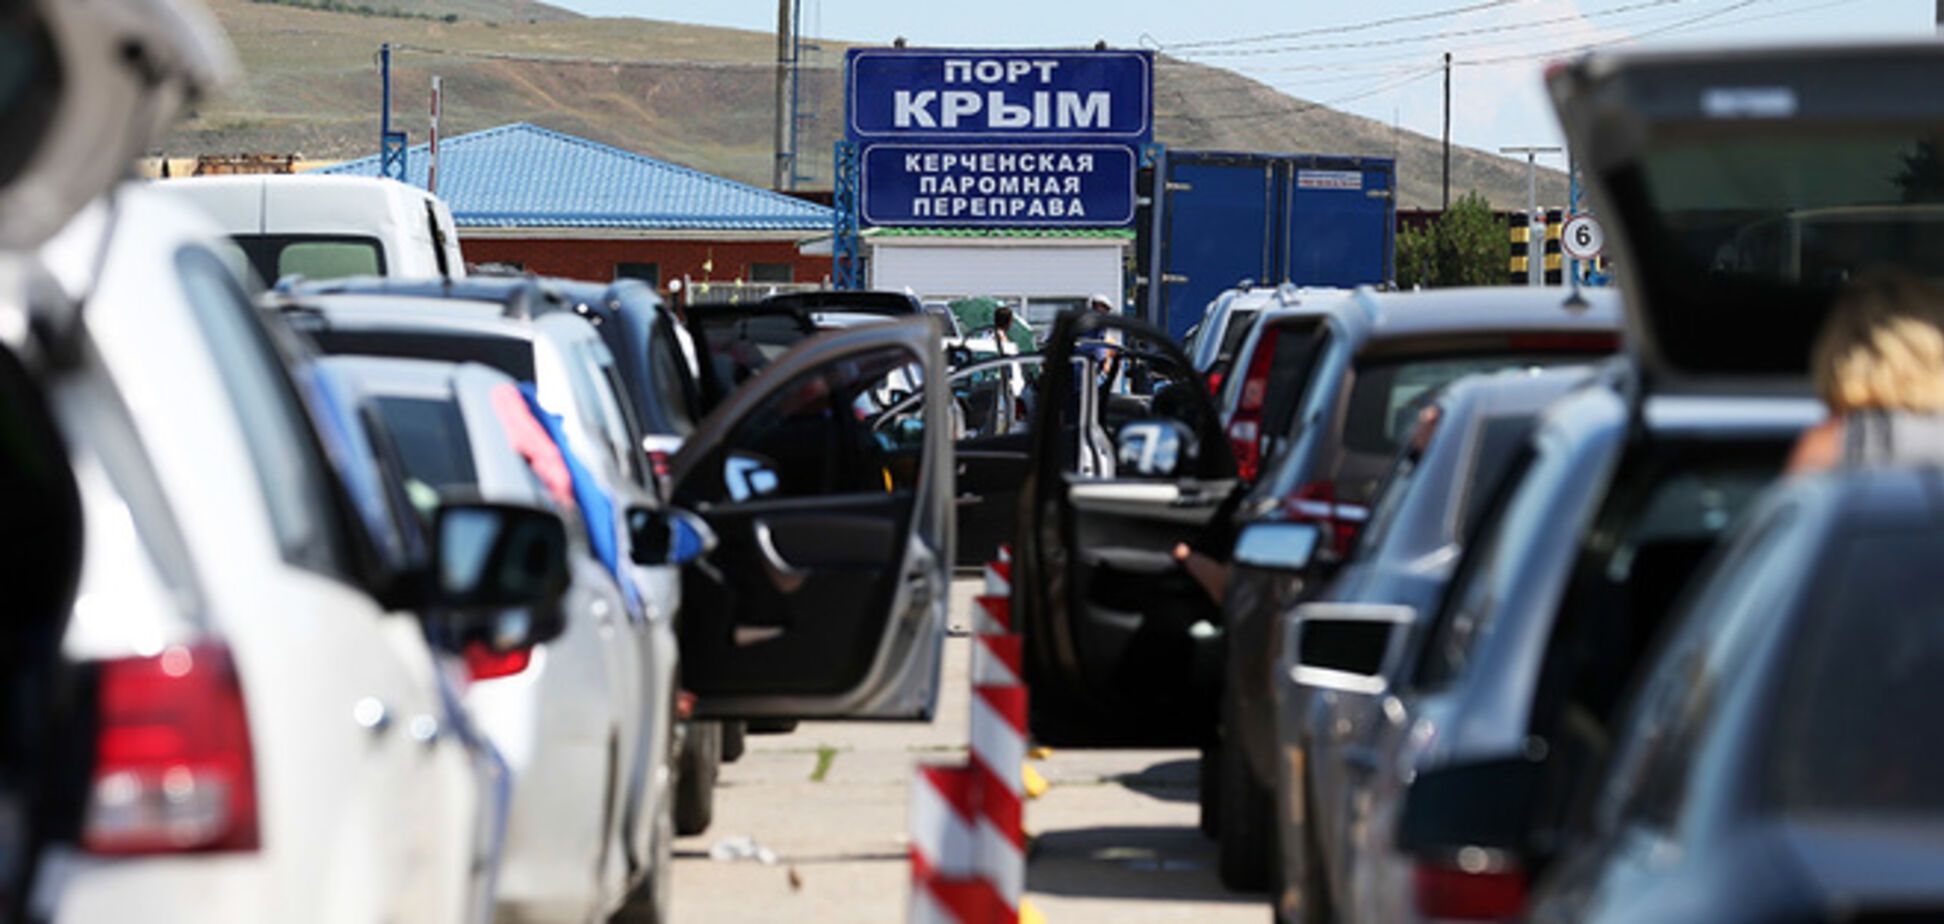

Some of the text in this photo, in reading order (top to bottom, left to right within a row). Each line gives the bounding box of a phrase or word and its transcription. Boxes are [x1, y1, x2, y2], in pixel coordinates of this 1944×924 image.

[944, 60, 1058, 83] ПОРТ
[894, 90, 1111, 128] КРЫМ
[905, 153, 1094, 172] КЕРЧЕНСКАЯ
[920, 176, 1080, 194] ПАРОМНАЯ
[913, 198, 1085, 217] ПЕРЕПРАВА
[1575, 224, 1591, 246] 6
